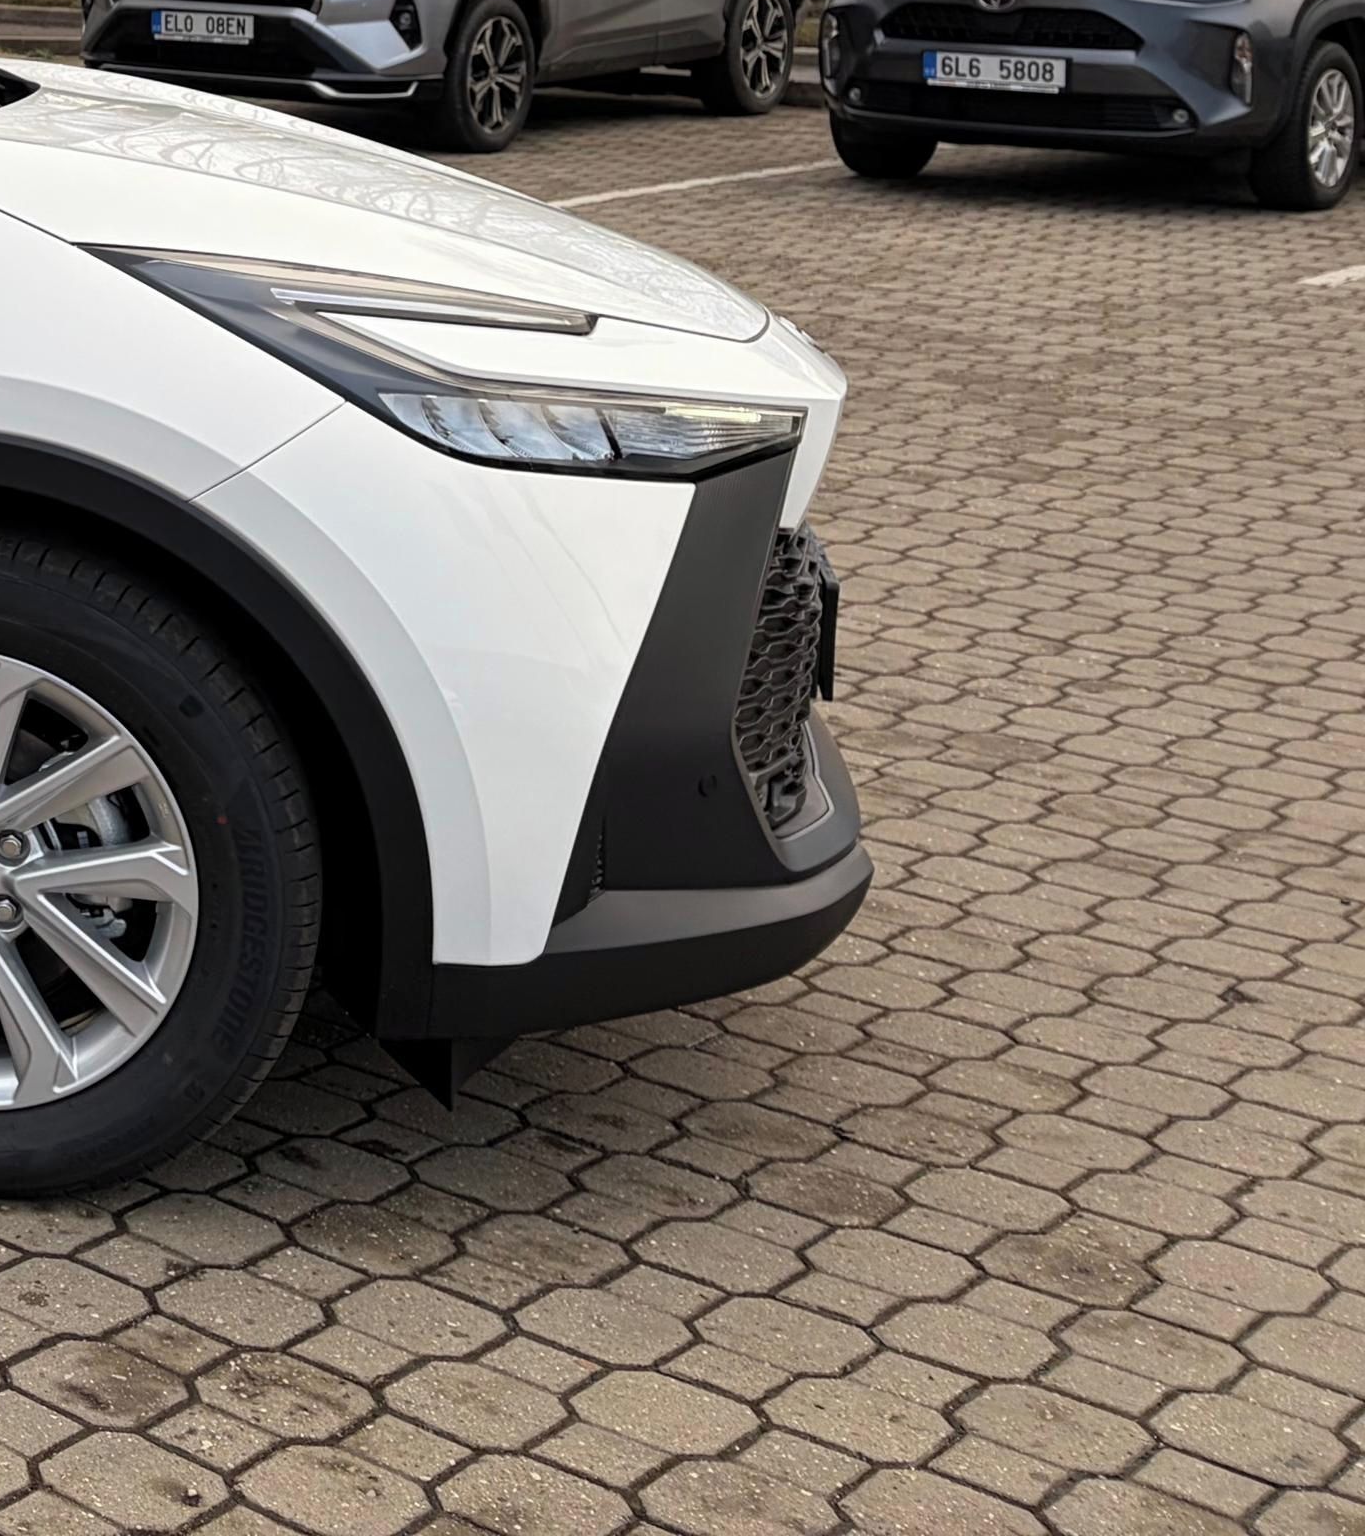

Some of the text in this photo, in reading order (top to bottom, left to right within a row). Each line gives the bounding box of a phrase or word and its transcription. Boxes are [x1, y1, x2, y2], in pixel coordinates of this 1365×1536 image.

[940, 55, 1056, 83] 6L6 5808
[209, 814, 270, 1058] BRIDGESTONE
